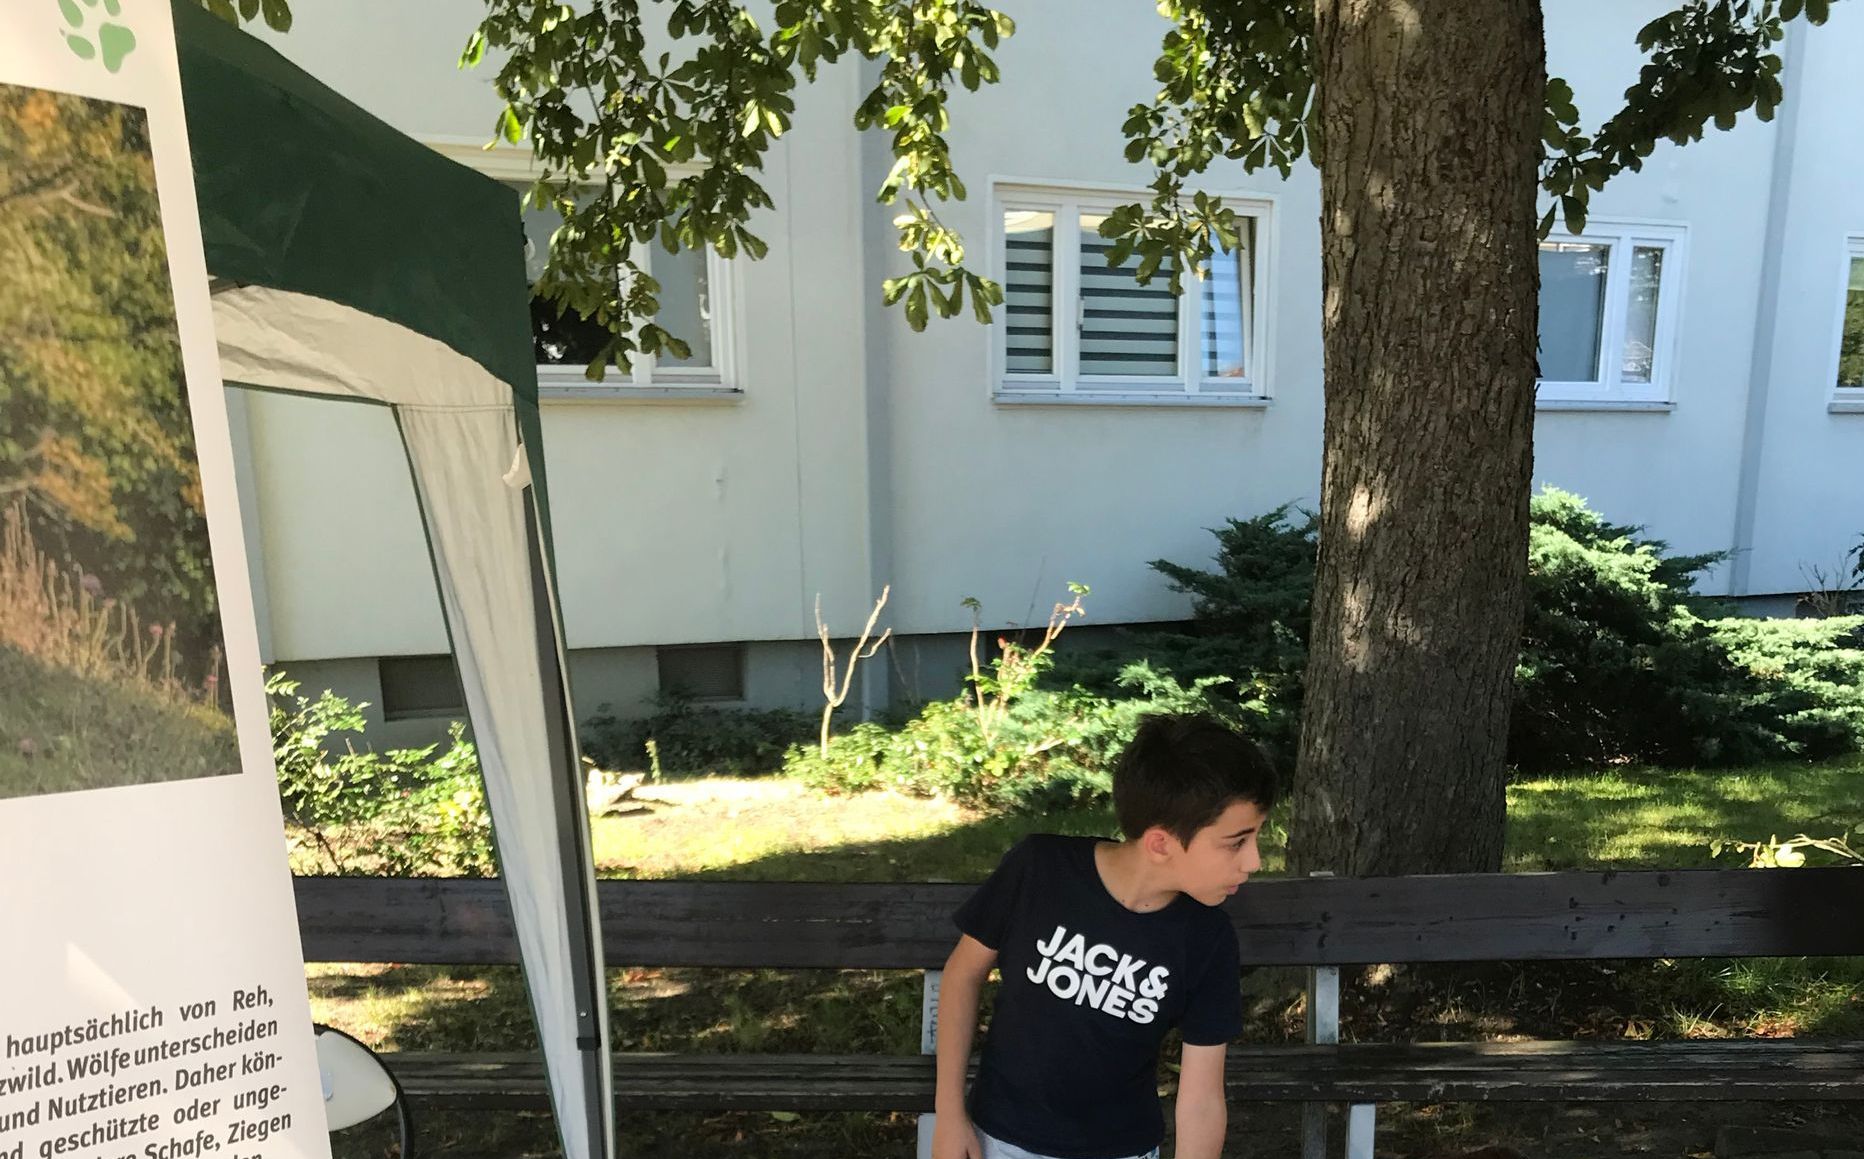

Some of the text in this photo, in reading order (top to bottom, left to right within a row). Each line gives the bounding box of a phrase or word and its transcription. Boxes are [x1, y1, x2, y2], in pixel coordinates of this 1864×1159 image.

[6, 984, 274, 1059] hauptsächlich von Reh,
[1026, 957, 1160, 1025] JONES
[0, 1018, 278, 1097] zwild. Wölfe unterscheiden
[0, 1050, 283, 1134] und Nutztieren. Daher kön-
[173, 1097, 221, 1125] oder
[233, 1084, 288, 1111] unge-
[227, 1113, 292, 1145] Ziegen
